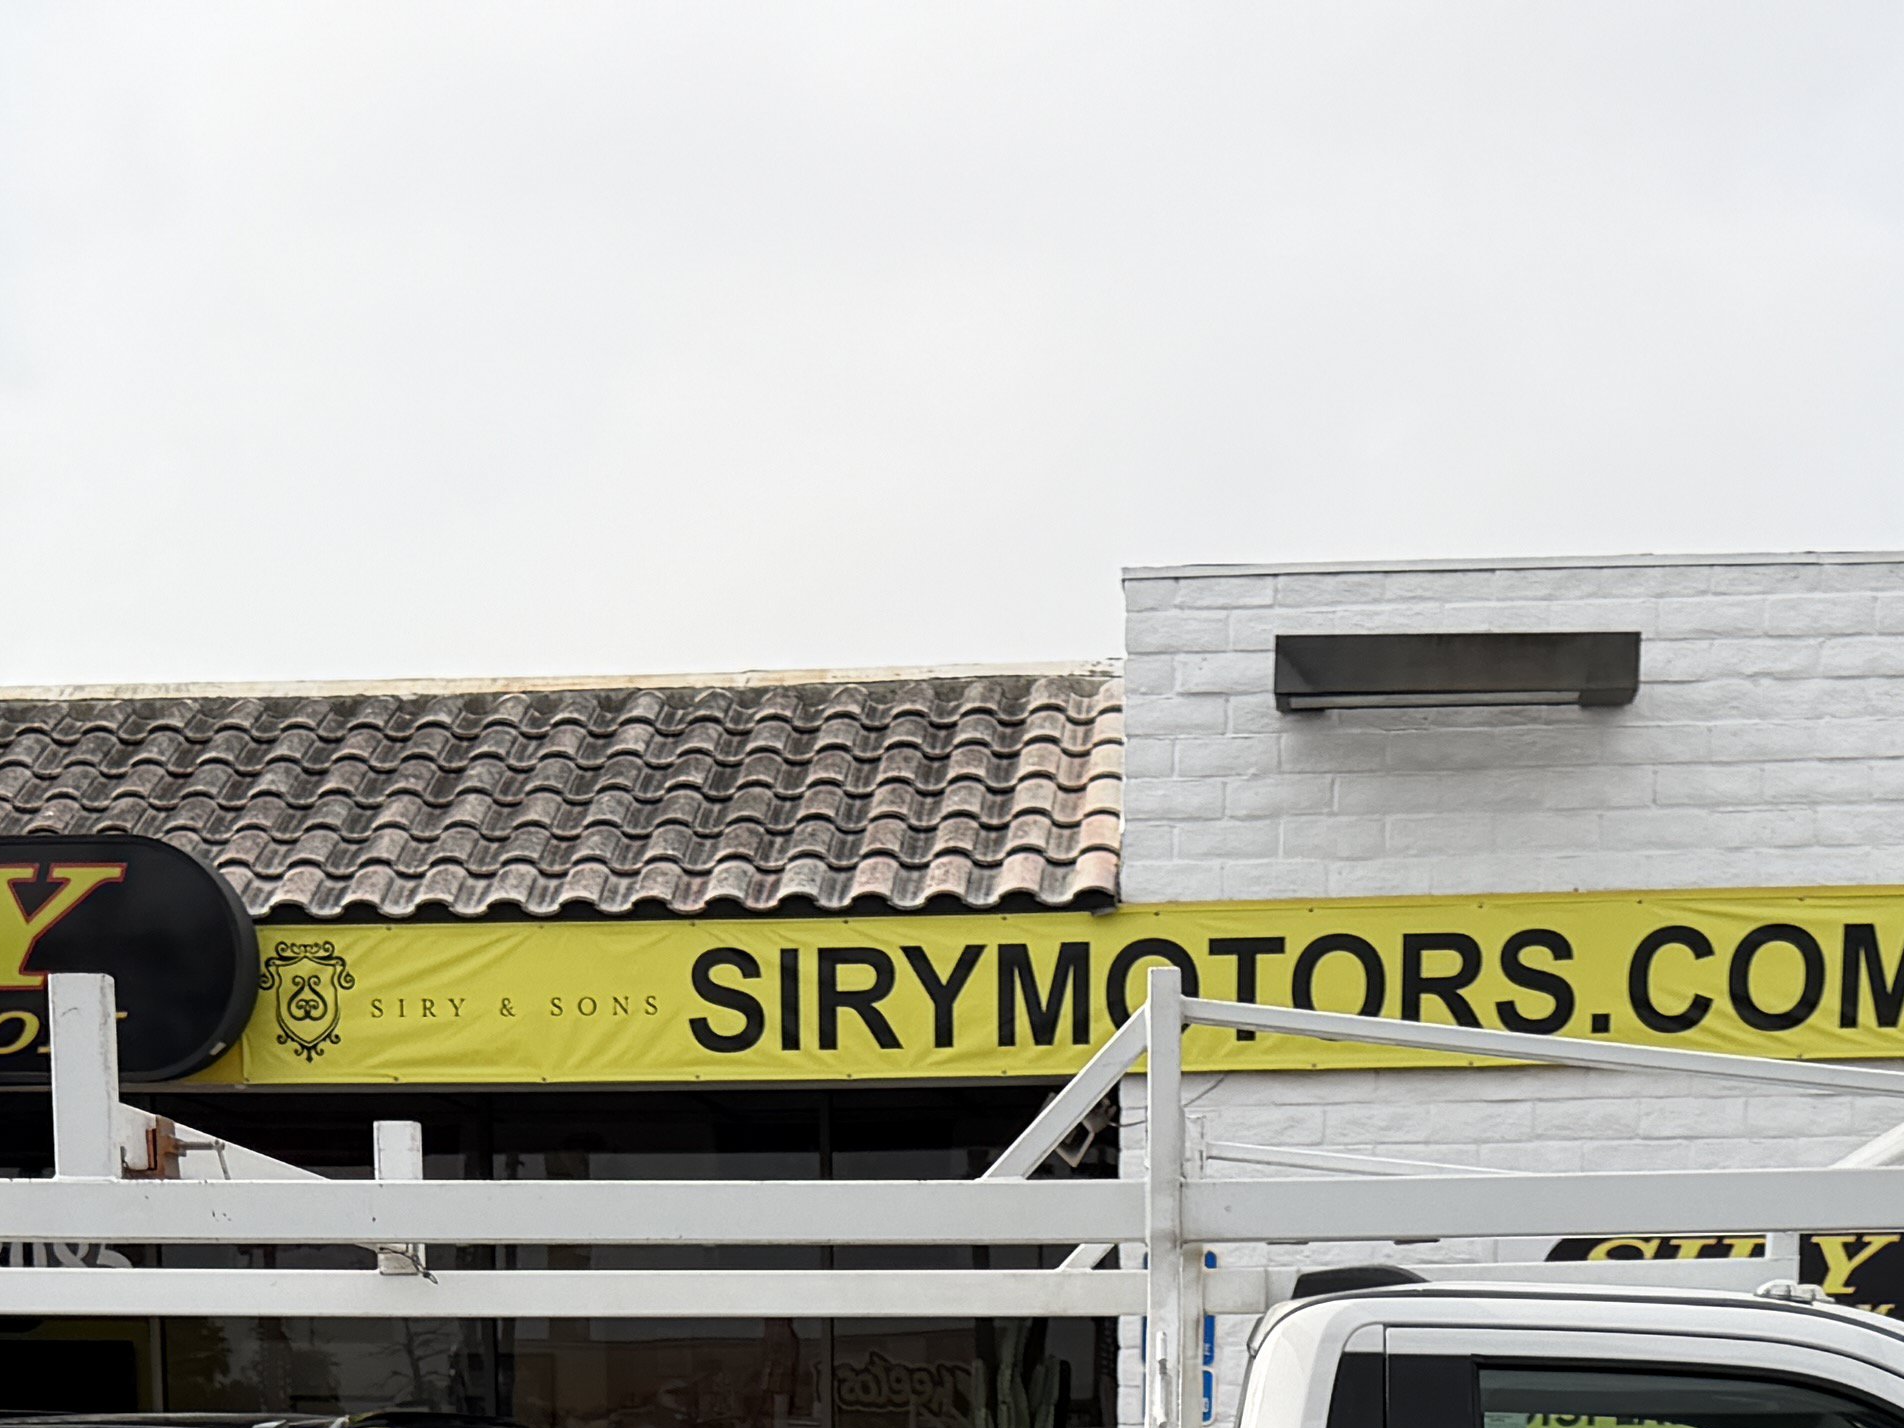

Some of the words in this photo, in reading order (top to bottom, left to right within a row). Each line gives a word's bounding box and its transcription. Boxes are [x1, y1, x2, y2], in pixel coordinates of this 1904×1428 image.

[370, 997, 466, 1018] SIRY
[499, 998, 516, 1017] &
[550, 996, 658, 1017] SONS
